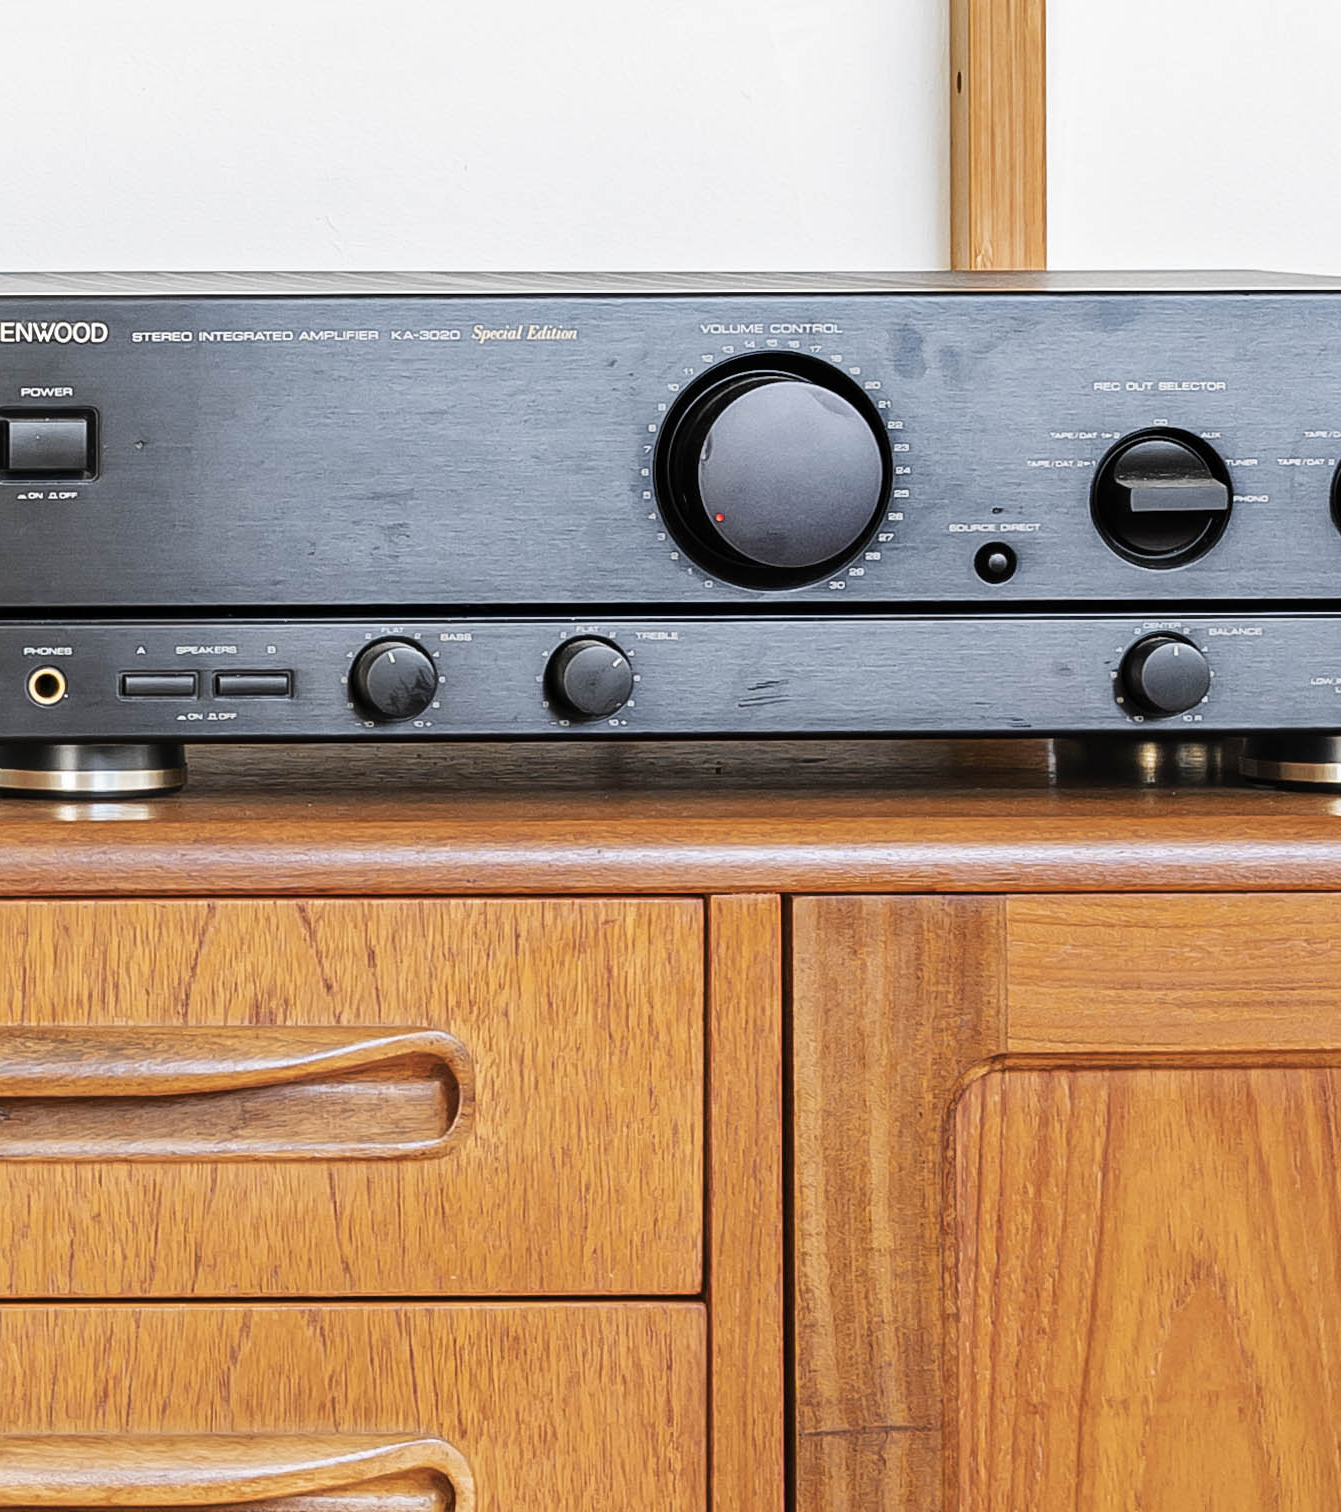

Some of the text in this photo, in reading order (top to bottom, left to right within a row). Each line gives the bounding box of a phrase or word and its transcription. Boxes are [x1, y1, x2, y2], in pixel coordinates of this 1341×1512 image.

[700, 323, 843, 334] VOLUME CONTROL
[132, 323, 577, 344] STEREO INTEGRATED AMPLIFIER KA-3020 Special Edition
[1093, 381, 1226, 391] REC OUT SELECTOR
[20, 387, 73, 397] POWER
[1027, 460, 1073, 468] TAPE/DAT
[1225, 458, 1258, 466] TUNER
[1277, 458, 1325, 466] TAPE/DAT
[28, 491, 78, 500] ON OFF
[1232, 495, 1269, 503] PHONO
[948, 523, 1041, 532] SOURCE DIRECT
[635, 631, 679, 641] TREBLE
[1209, 627, 1263, 636] BALANCE
[439, 632, 472, 642] BASS
[23, 646, 73, 656] PHONES
[136, 646, 146, 655] A
[175, 646, 237, 655] SPEAKERS
